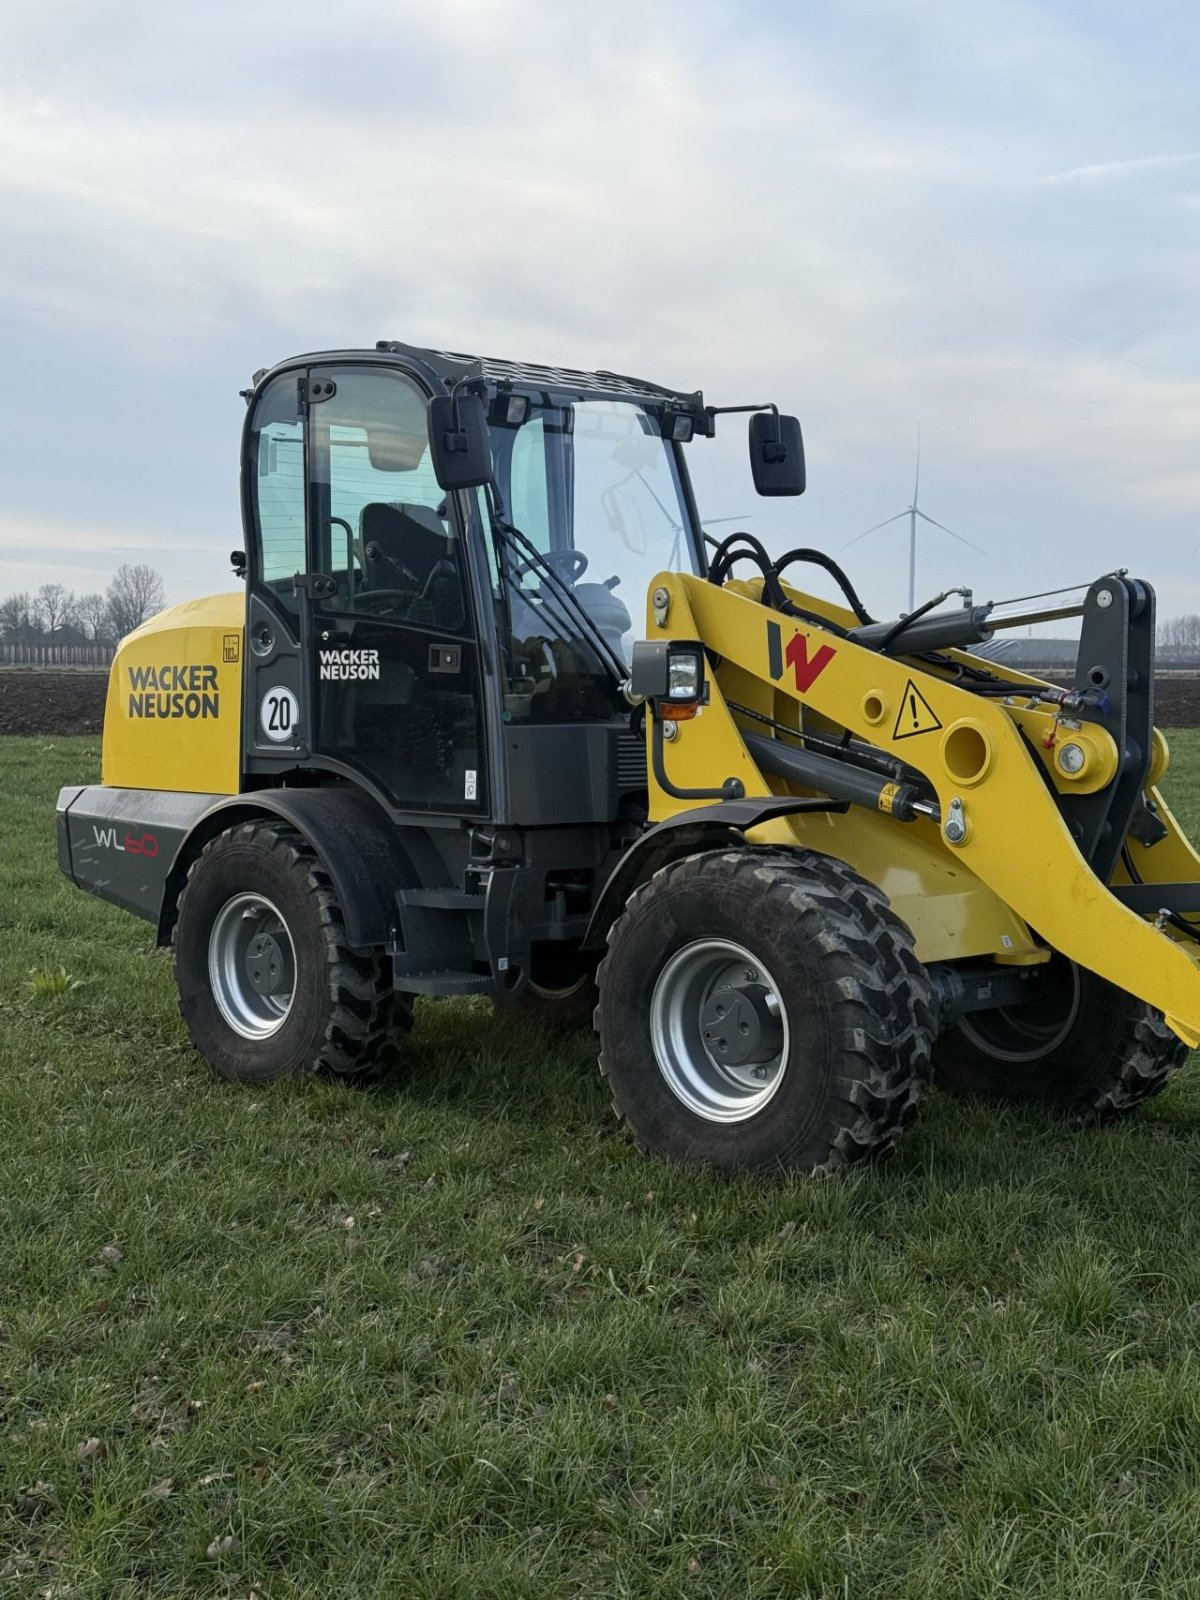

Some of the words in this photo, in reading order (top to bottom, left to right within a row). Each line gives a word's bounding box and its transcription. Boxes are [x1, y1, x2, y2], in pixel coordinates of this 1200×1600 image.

[319, 649, 380, 665] WACKER
[128, 665, 219, 691] WACKER
[320, 665, 380, 680] NEUSON
[129, 693, 219, 719] NEUSON
[268, 696, 291, 731] 20
